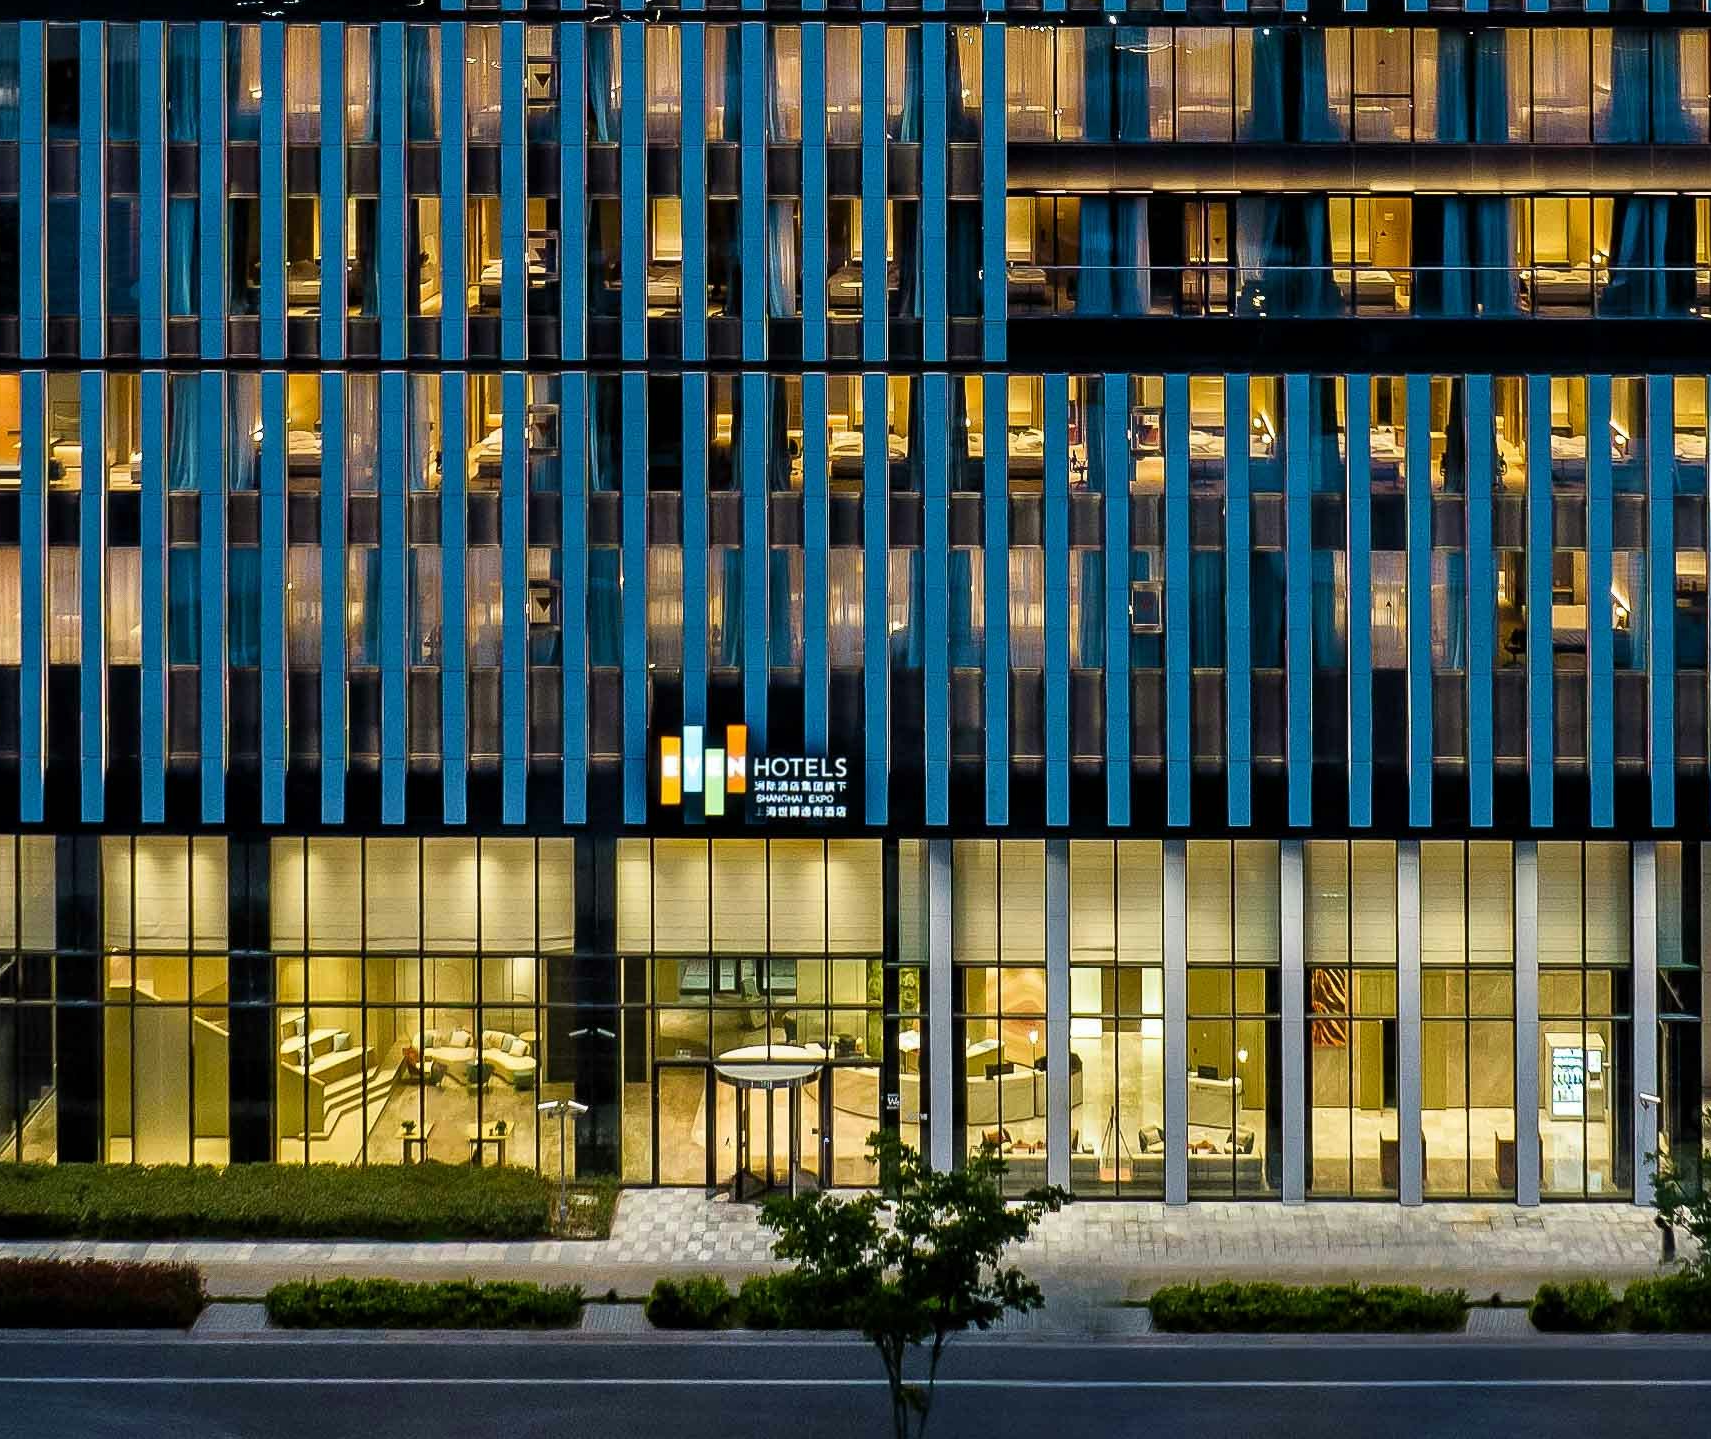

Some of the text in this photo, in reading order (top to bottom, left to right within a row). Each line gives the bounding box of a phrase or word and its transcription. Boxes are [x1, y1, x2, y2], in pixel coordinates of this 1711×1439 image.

[753, 757, 847, 777] HOTELS
[756, 793, 834, 803] SHANGHAI EXPO
